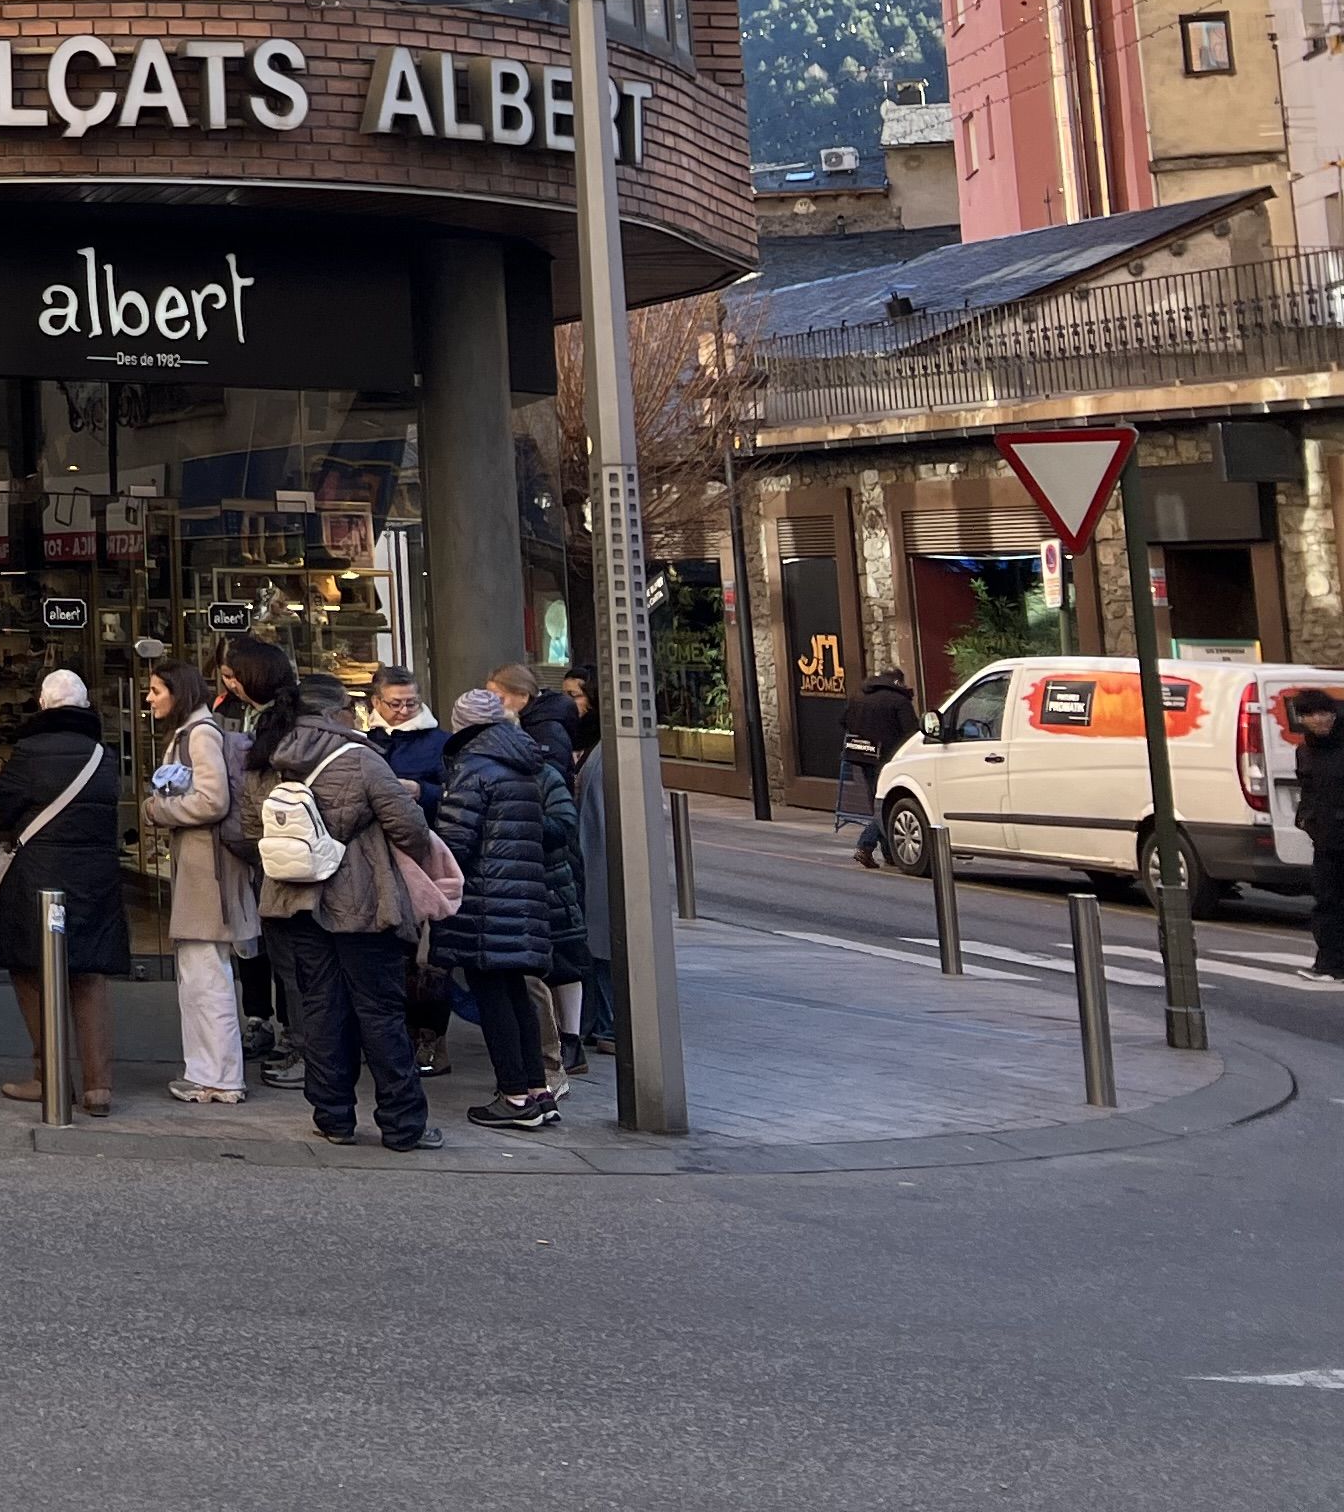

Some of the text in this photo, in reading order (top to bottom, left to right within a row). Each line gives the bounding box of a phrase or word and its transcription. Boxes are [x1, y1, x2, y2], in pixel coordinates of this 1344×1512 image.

[38, 246, 255, 344] albert
[116, 351, 181, 368] Des de 1982
[49, 605, 81, 621] albert
[800, 674, 846, 693] JAPOMEX
